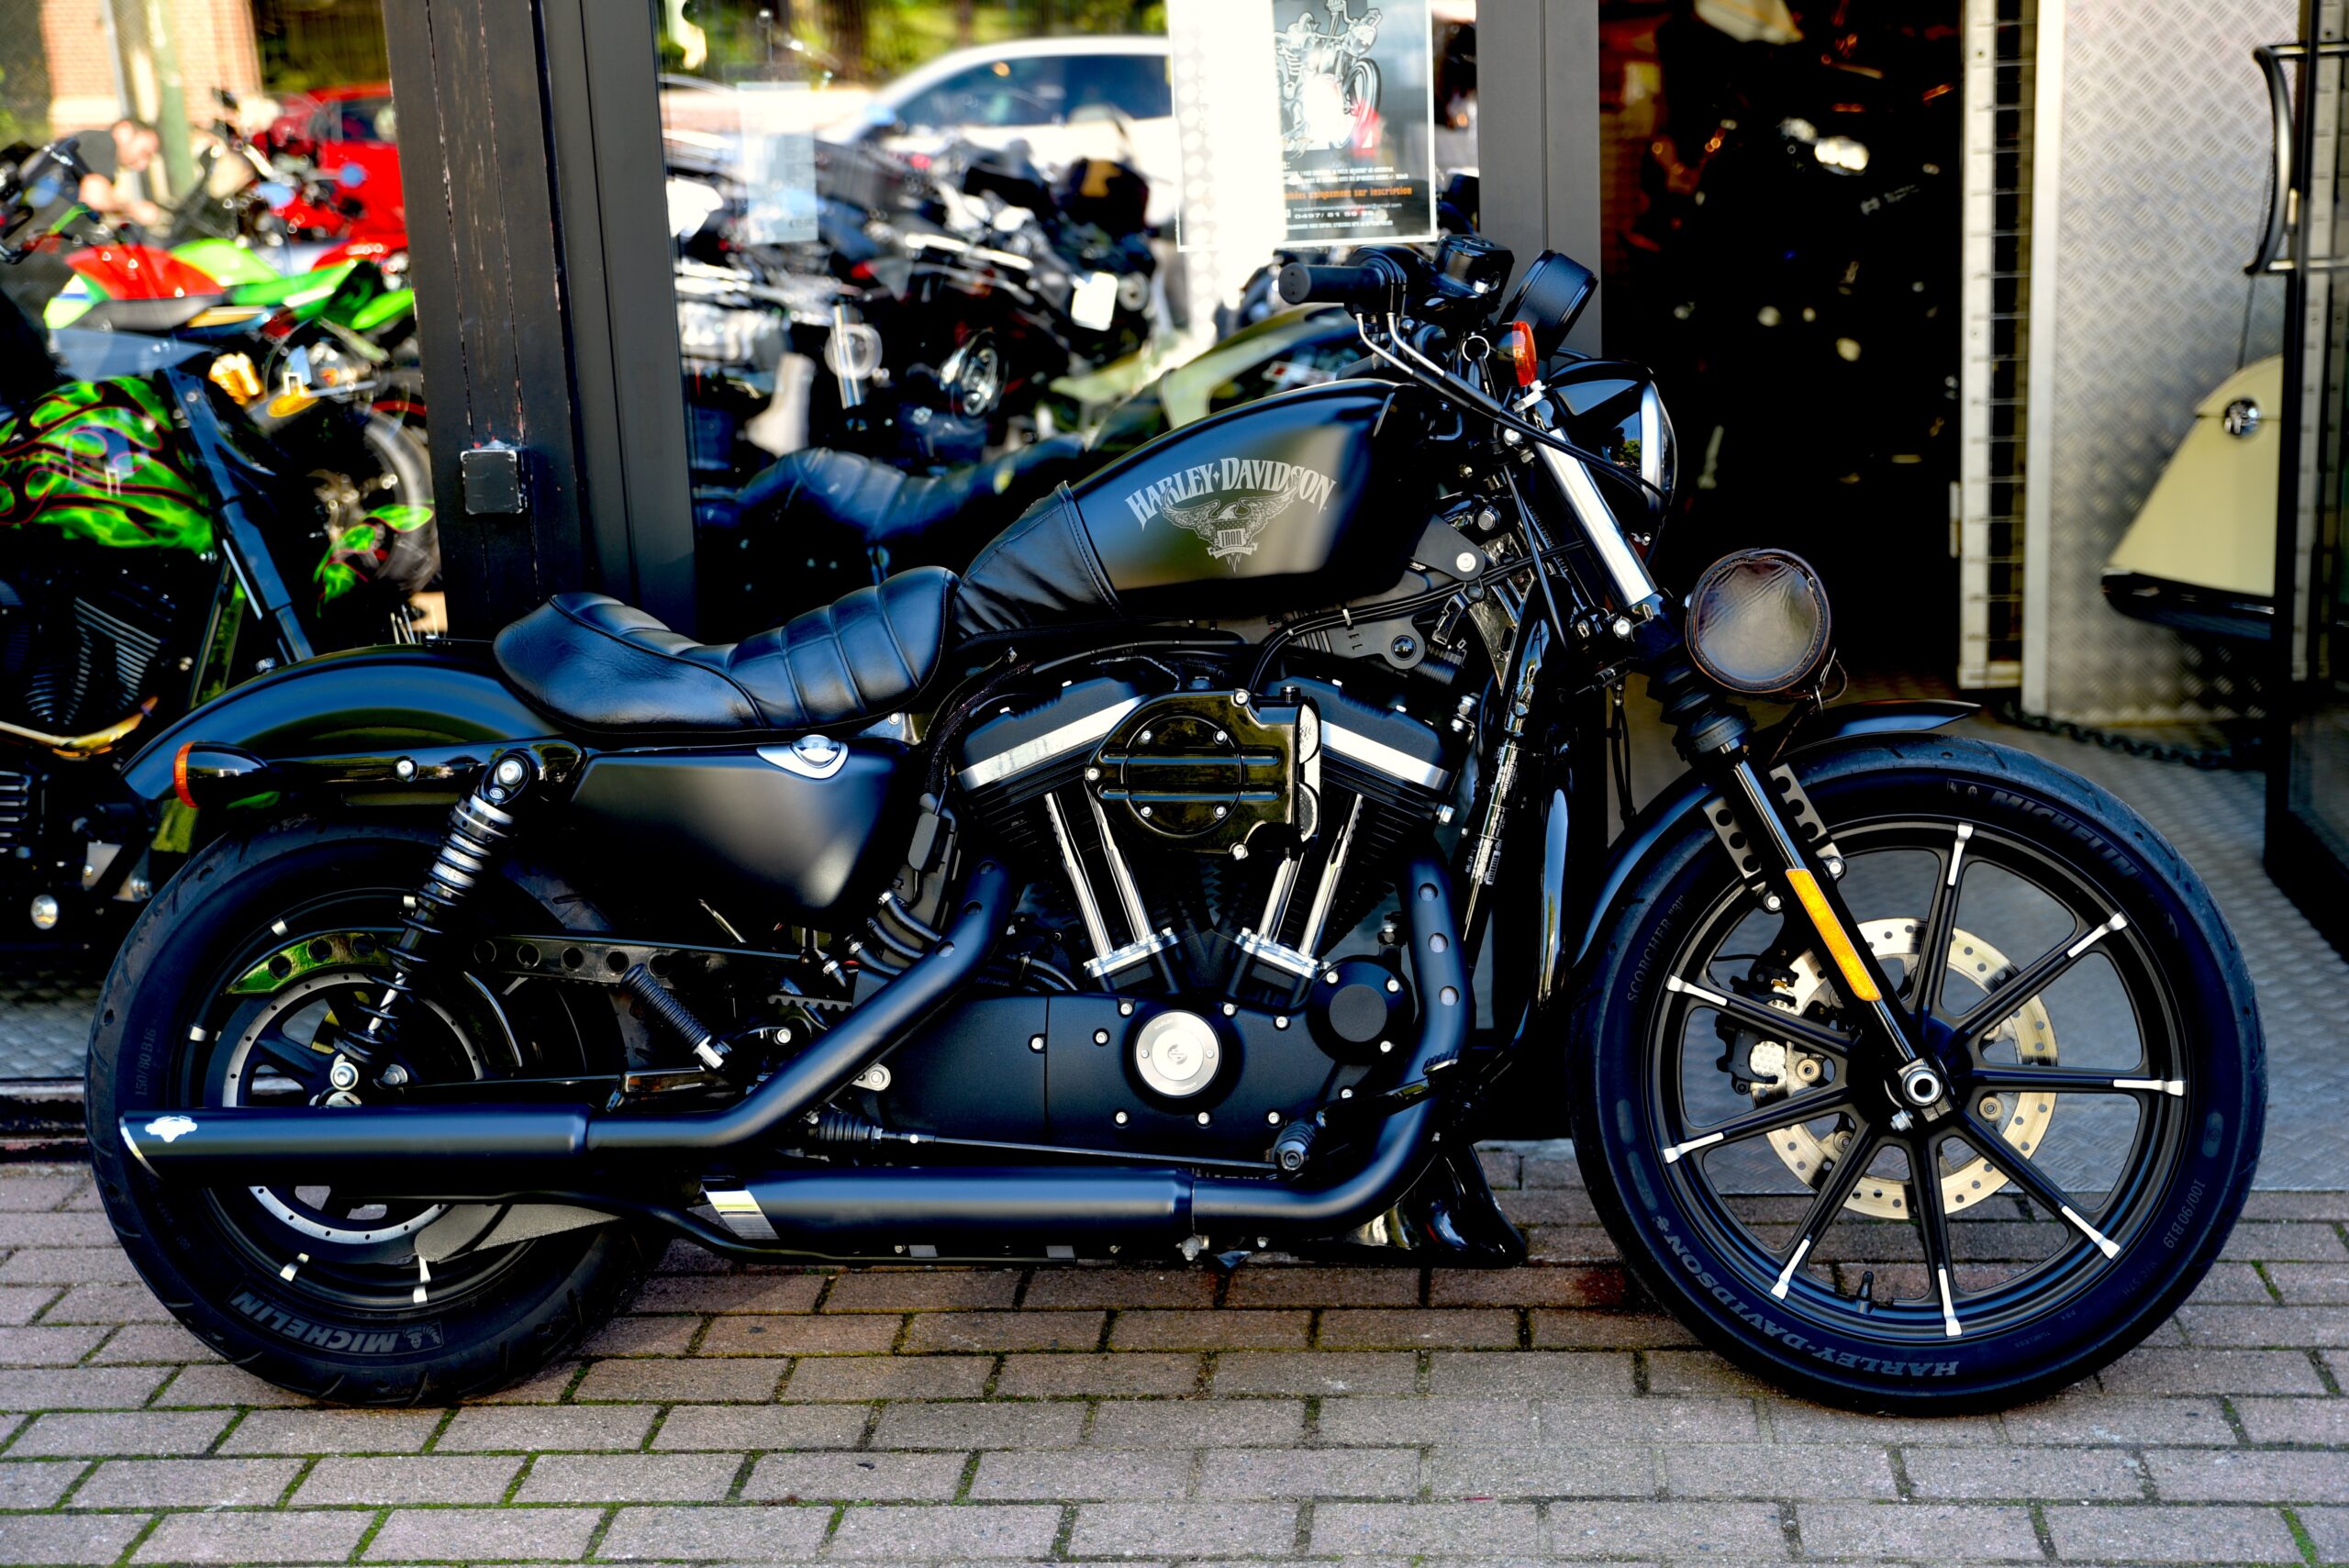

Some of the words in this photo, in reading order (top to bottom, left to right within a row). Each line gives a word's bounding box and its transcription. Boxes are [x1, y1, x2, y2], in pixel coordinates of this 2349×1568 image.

[1221, 530, 1242, 547] IRON
[1988, 790, 2140, 877] MICHELIN
[1627, 918, 1671, 1003] SCORCHER
[134, 1052, 152, 1095] 150/80
[2177, 1178, 2206, 1225] 100/90
[2163, 1221, 2186, 1249] B19
[228, 1291, 400, 1354] MICHELIN
[1664, 1234, 1960, 1379] HARLEY-DAVIDSON
